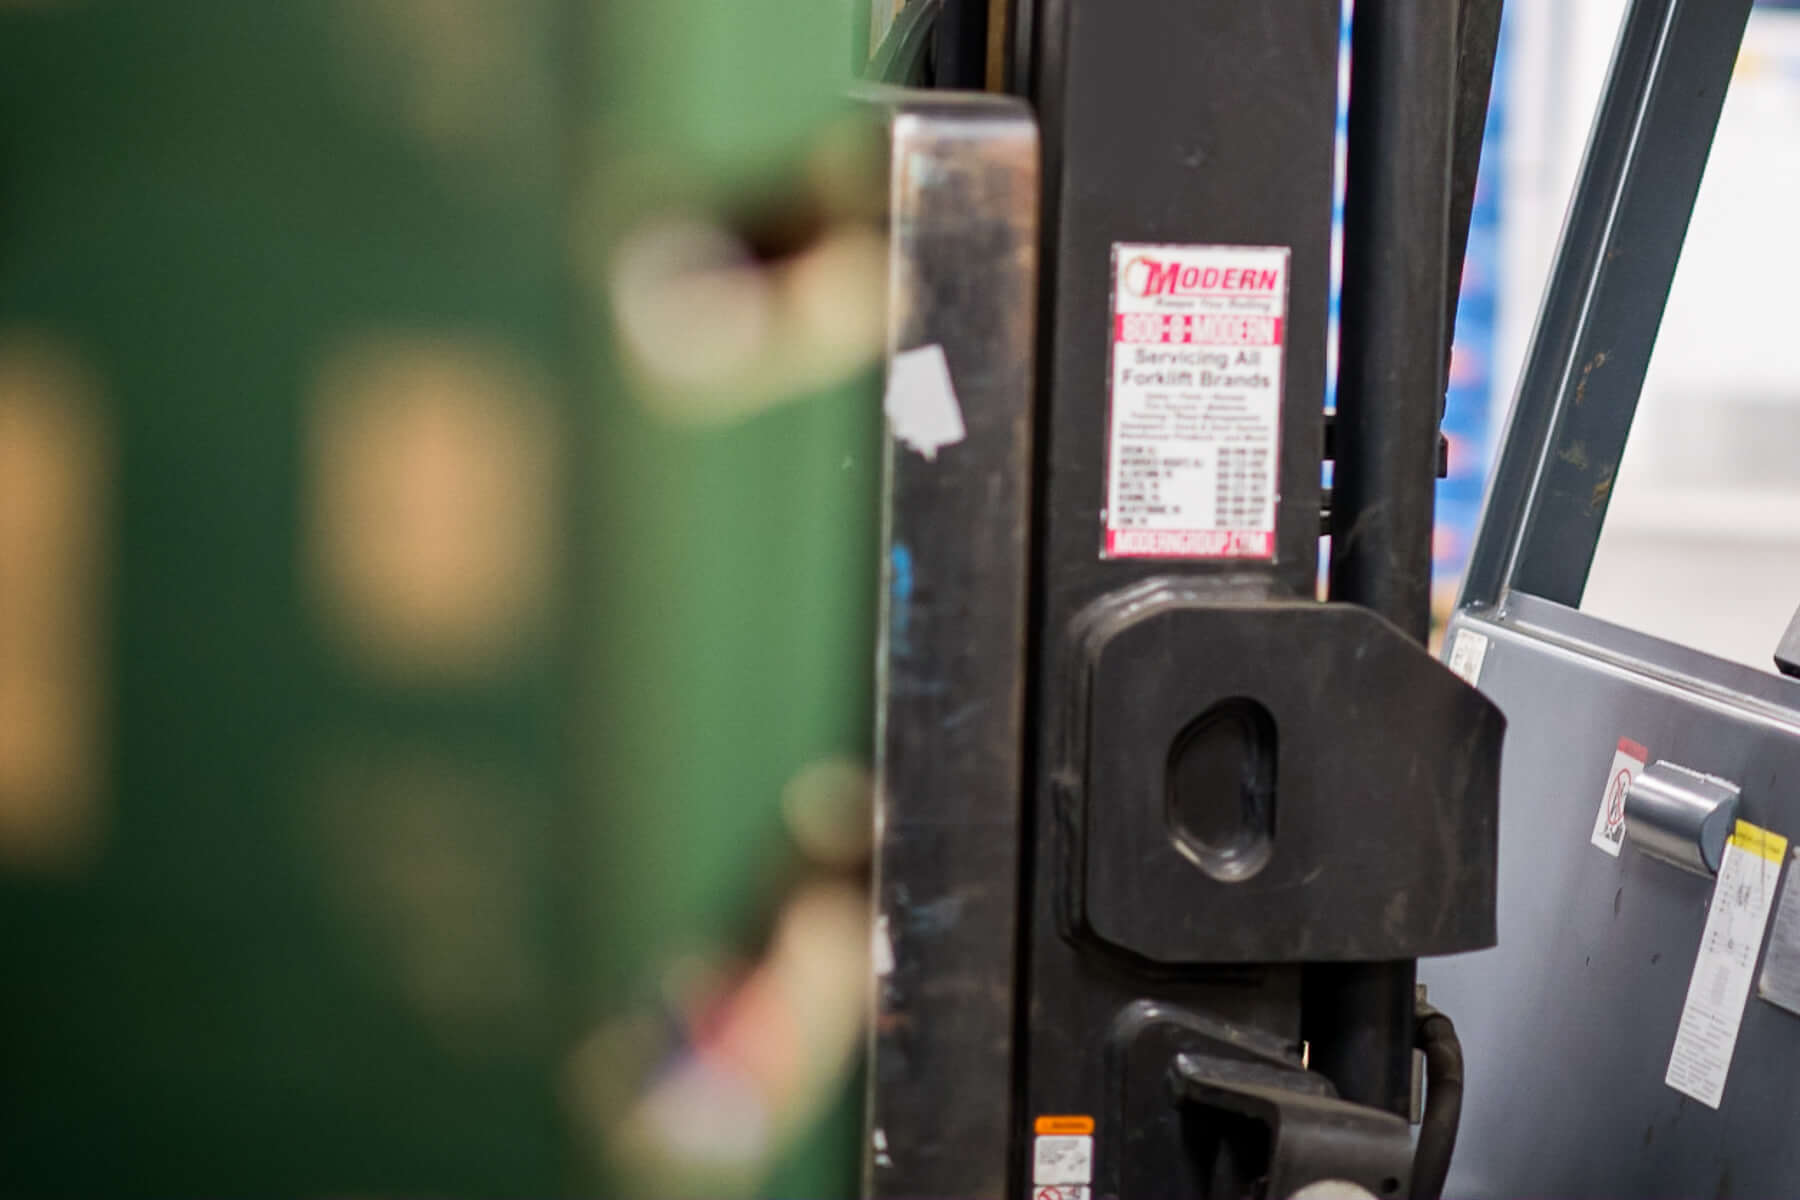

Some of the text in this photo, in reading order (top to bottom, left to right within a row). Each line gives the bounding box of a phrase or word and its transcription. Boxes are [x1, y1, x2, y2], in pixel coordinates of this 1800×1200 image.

[1141, 258, 1278, 296] MODERN
[1134, 349, 1261, 370] Servicing All
[1121, 368, 1270, 388] Forklift Brands
